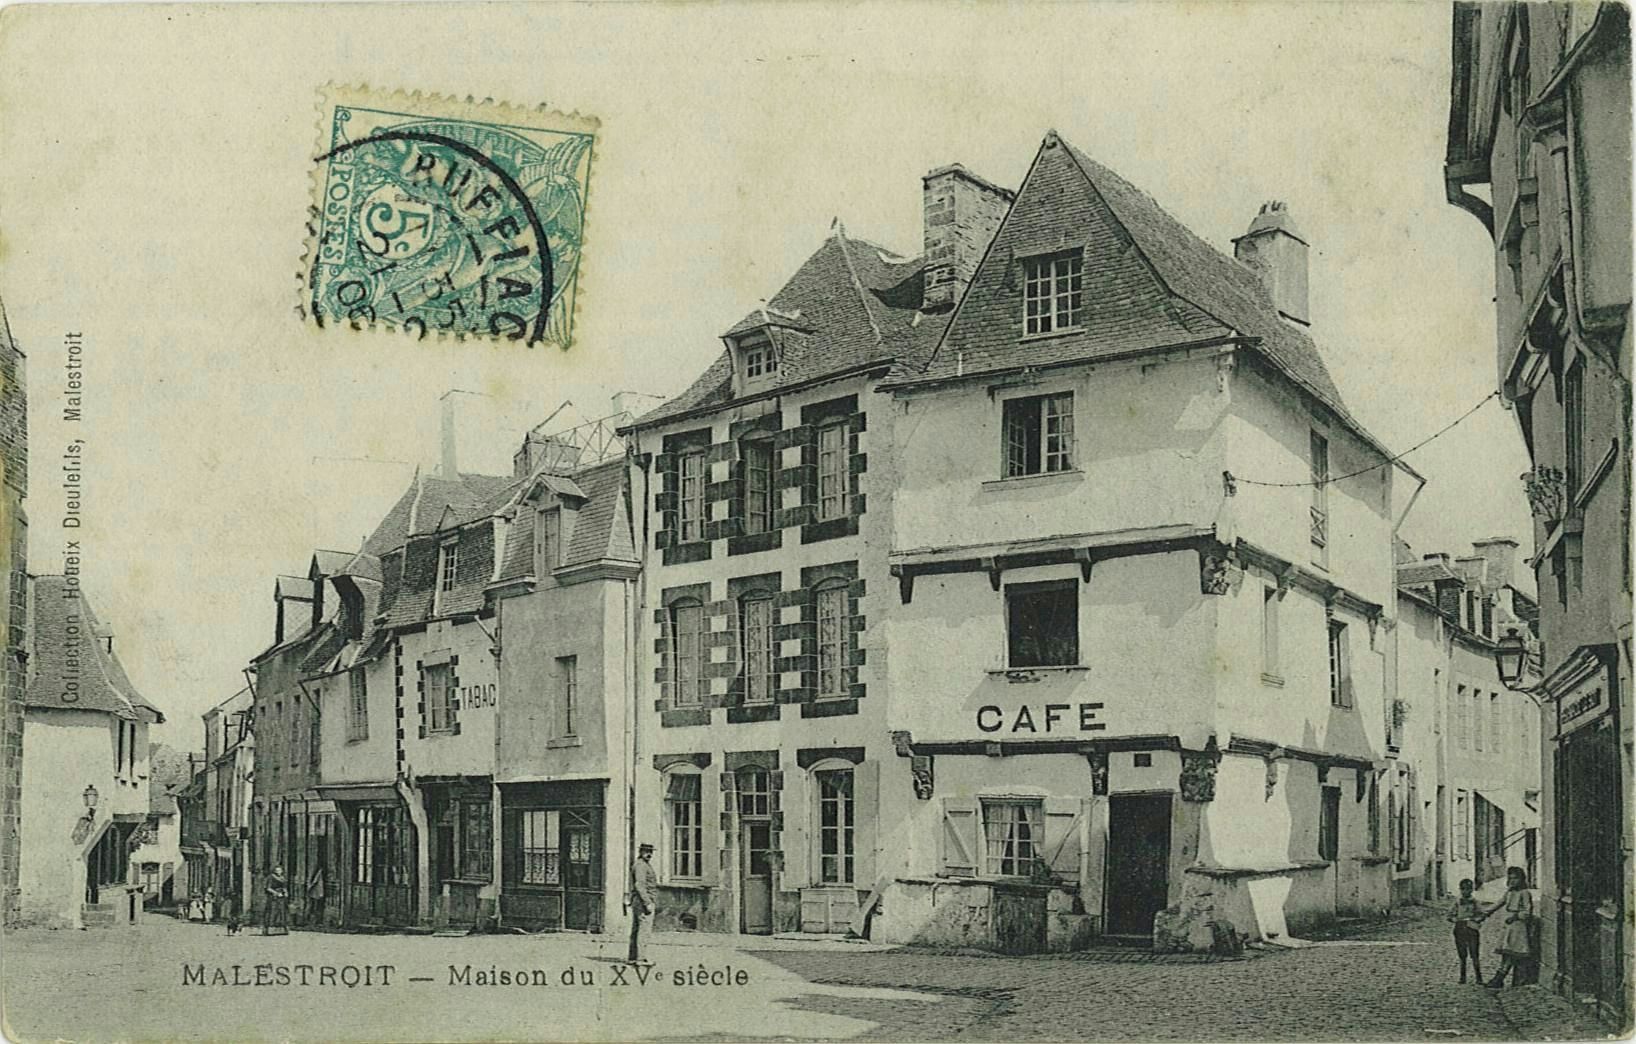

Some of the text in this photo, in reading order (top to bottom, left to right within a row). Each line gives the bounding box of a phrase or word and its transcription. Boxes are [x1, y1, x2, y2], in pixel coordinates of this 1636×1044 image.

[324, 167, 353, 260] POSTES
[460, 683, 496, 710] TABAC
[976, 702, 1106, 733] CAFE
